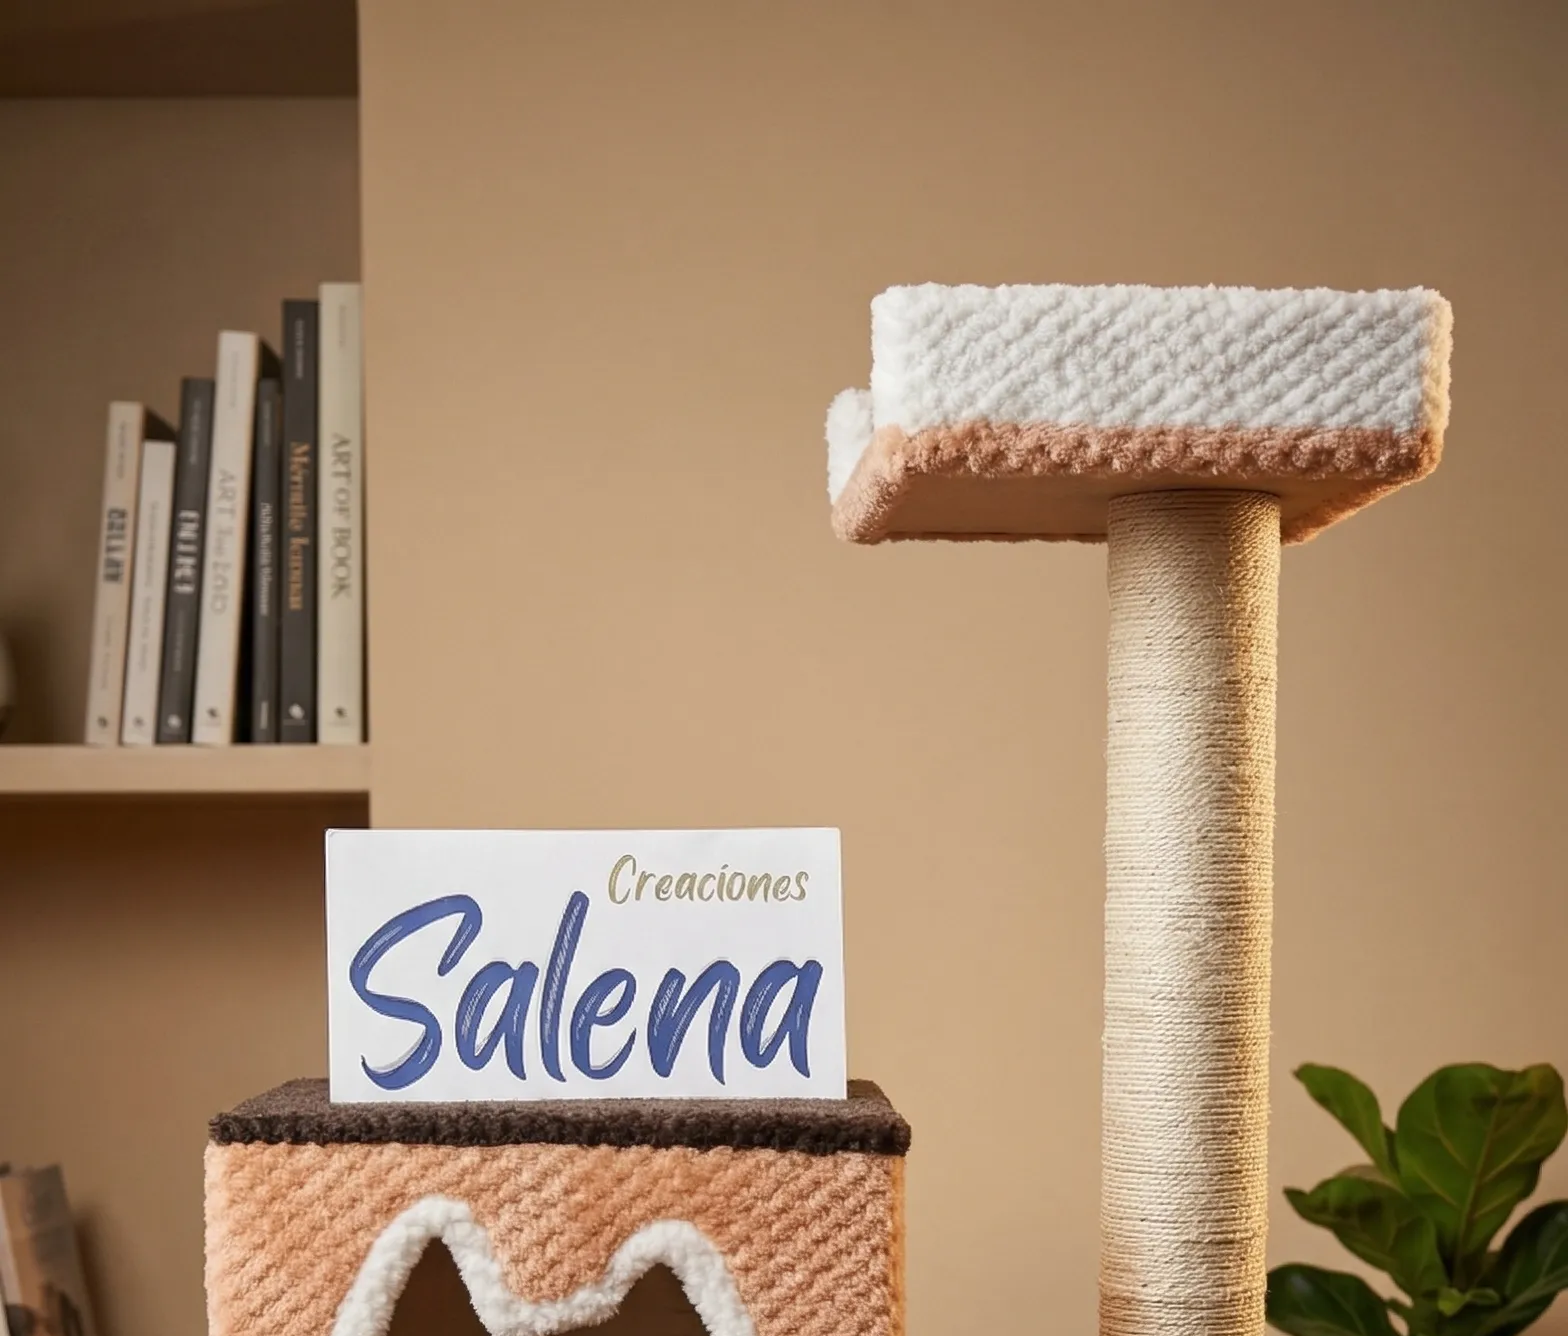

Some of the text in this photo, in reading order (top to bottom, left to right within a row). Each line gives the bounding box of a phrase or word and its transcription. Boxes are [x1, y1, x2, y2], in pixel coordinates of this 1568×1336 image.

[330, 433, 352, 482] ART
[330, 526, 352, 600] BOOK
[608, 854, 809, 904] Creaciones
[349, 891, 824, 1091] Salena
